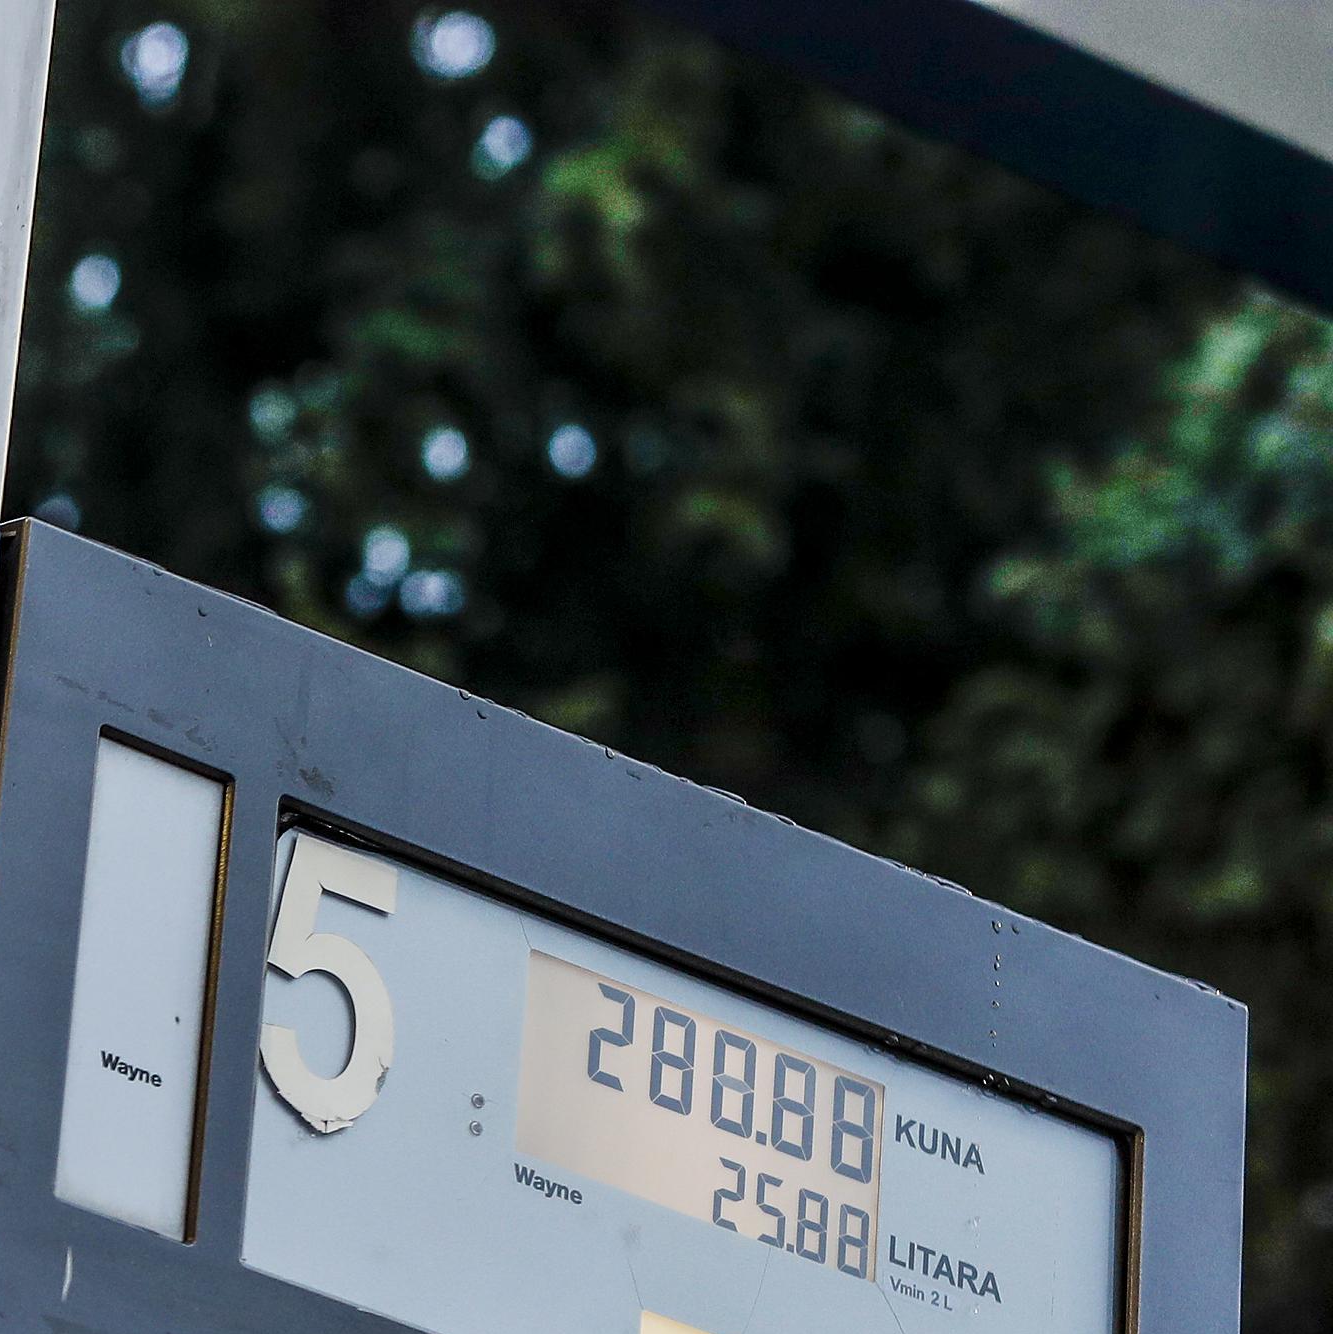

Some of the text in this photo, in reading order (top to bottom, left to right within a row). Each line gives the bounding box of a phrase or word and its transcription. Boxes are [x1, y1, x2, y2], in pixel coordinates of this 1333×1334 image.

[259, 833, 398, 1134] 5
[101, 1050, 162, 1087] Wayne
[895, 1114, 985, 1175] KUNA
[514, 1162, 583, 1205] Wayne
[712, 1157, 870, 1280] 25.88
[889, 1234, 1002, 1304] LITARA
[890, 1275, 953, 1311] Vmin 2 L
